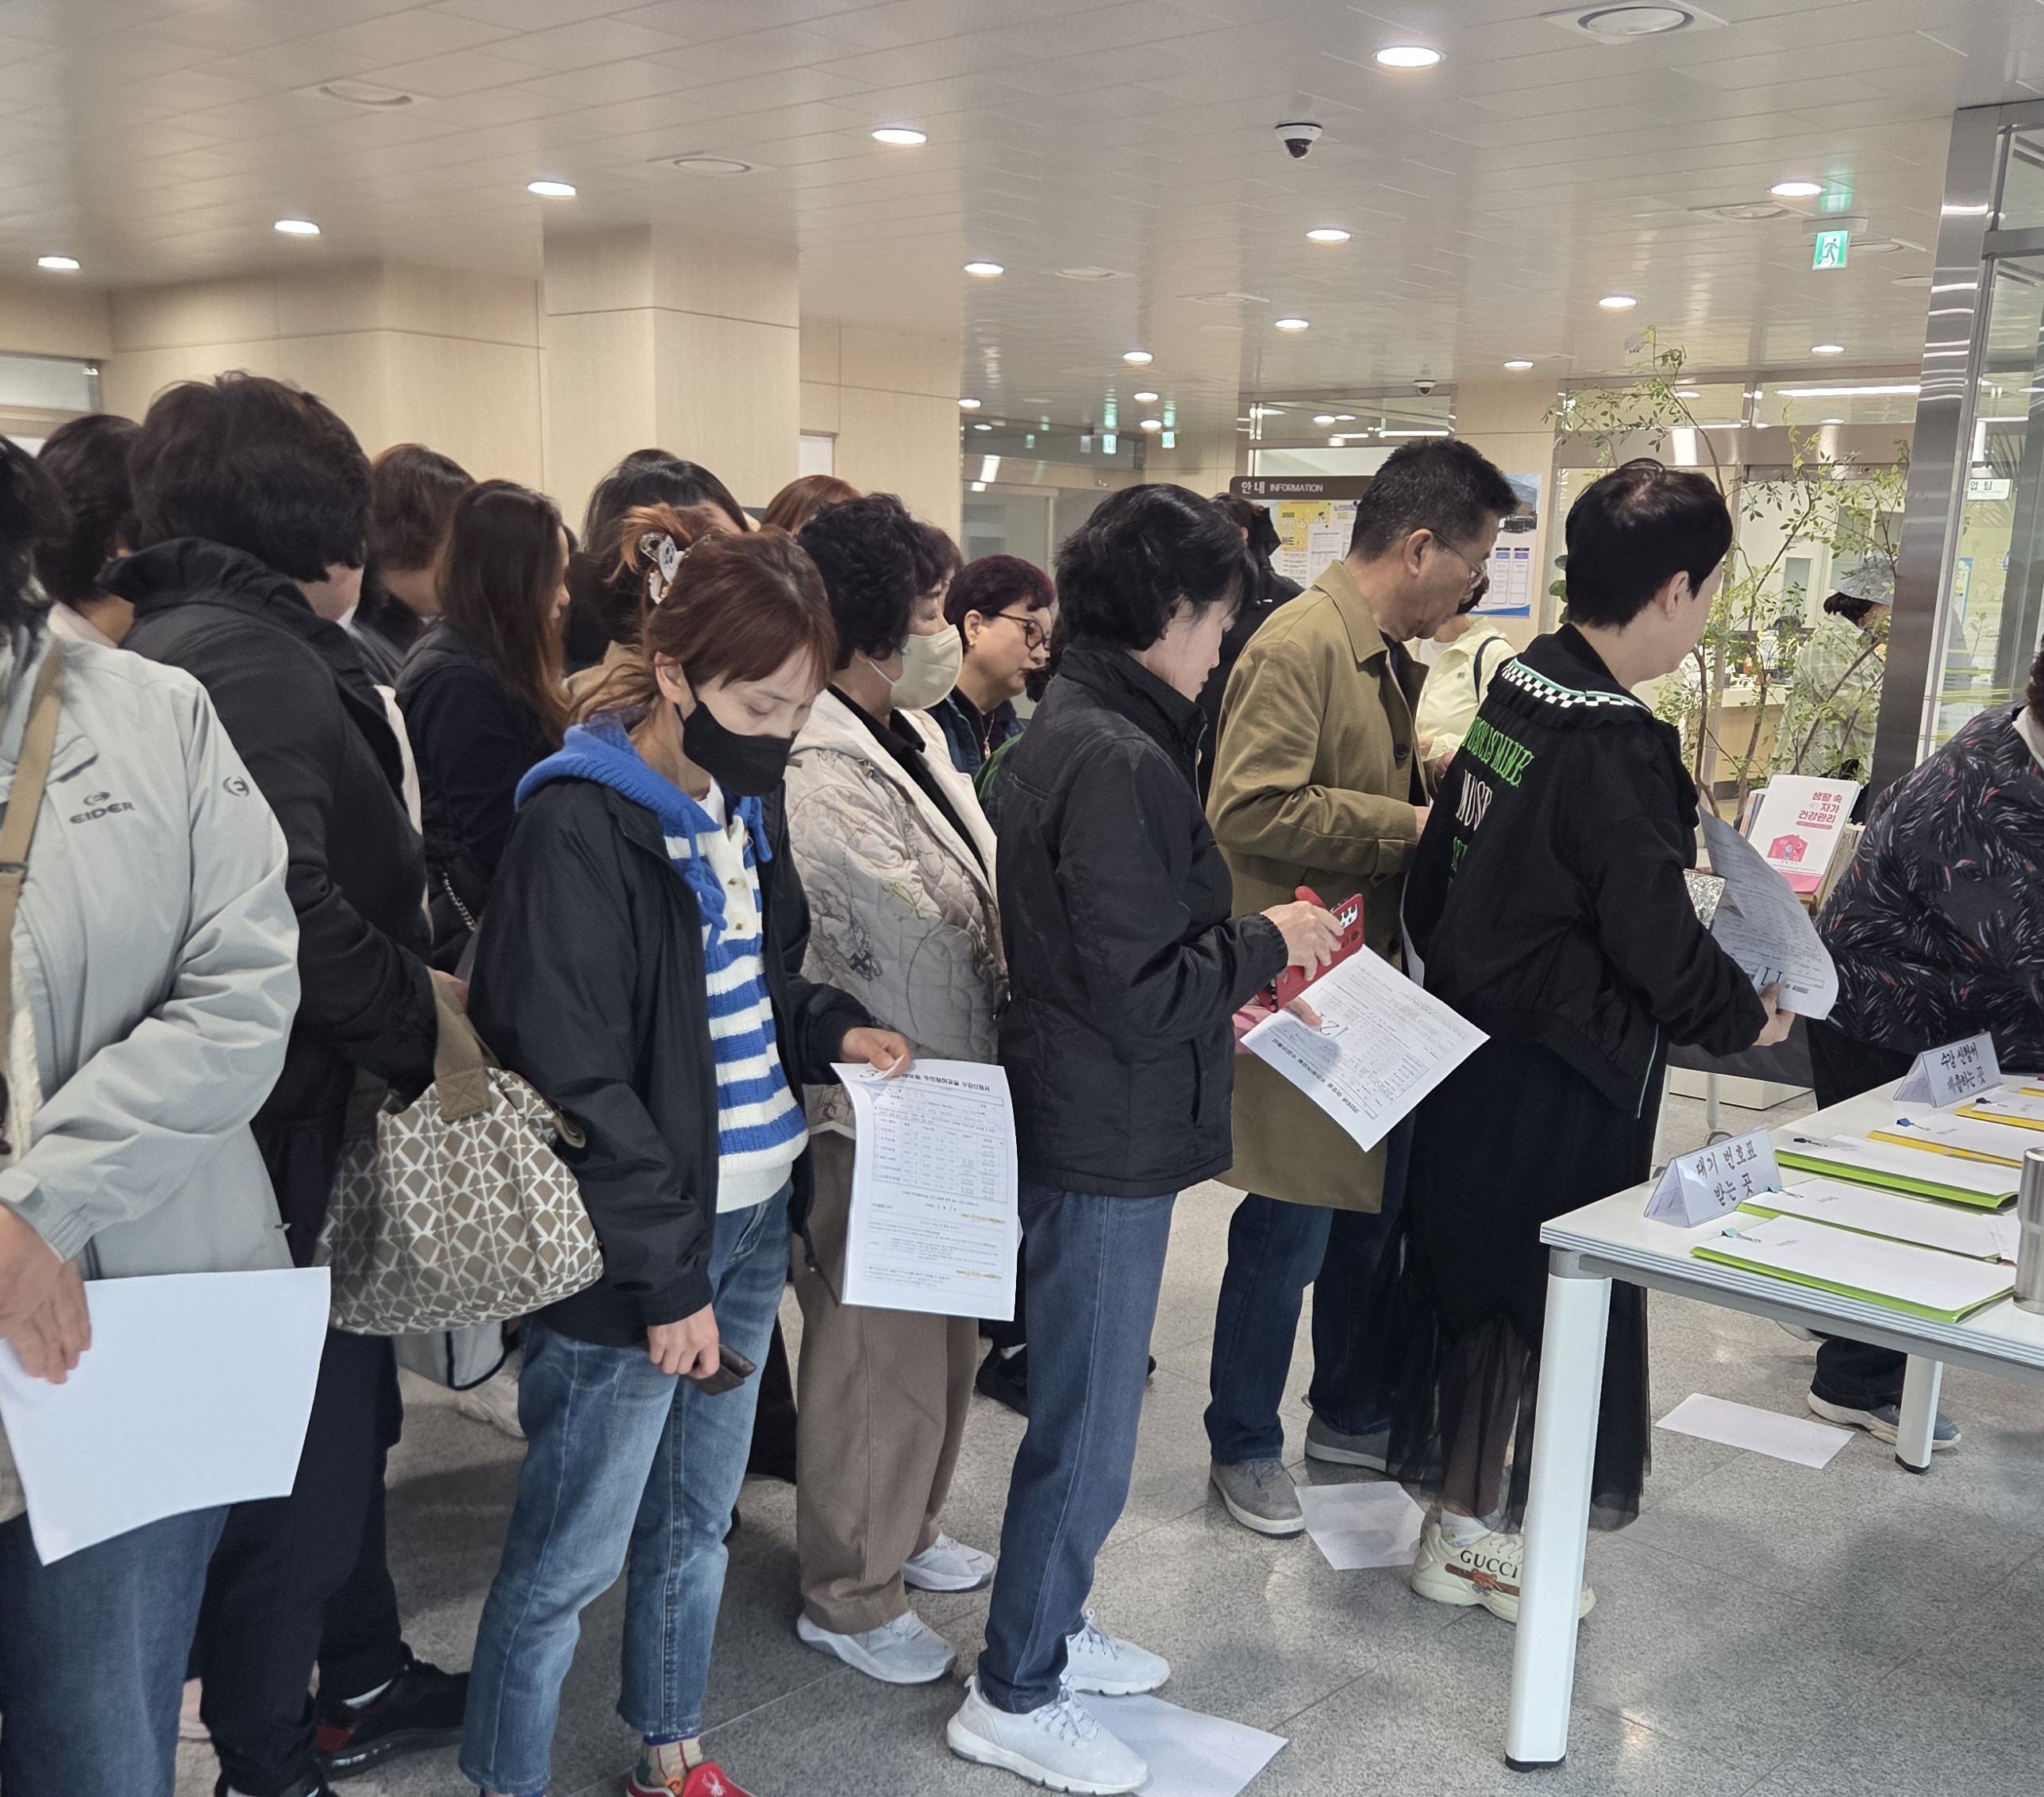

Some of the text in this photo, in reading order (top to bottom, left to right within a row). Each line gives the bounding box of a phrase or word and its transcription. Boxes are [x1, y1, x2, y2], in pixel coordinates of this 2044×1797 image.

[1241, 481, 1323, 494] 안내 INFORMATION
[1812, 791, 1842, 803] 생활 속
[69, 802, 135, 824] EIDER
[1799, 810, 1836, 823] 건강관리
[1819, 803, 1840, 814] 자기
[1957, 1041, 1979, 1065] 신청서
[1696, 1140, 1757, 1179] 대기 번호표
[1713, 1172, 1753, 1206] 받는 곳
[1460, 1549, 1519, 1579] GUCCI
